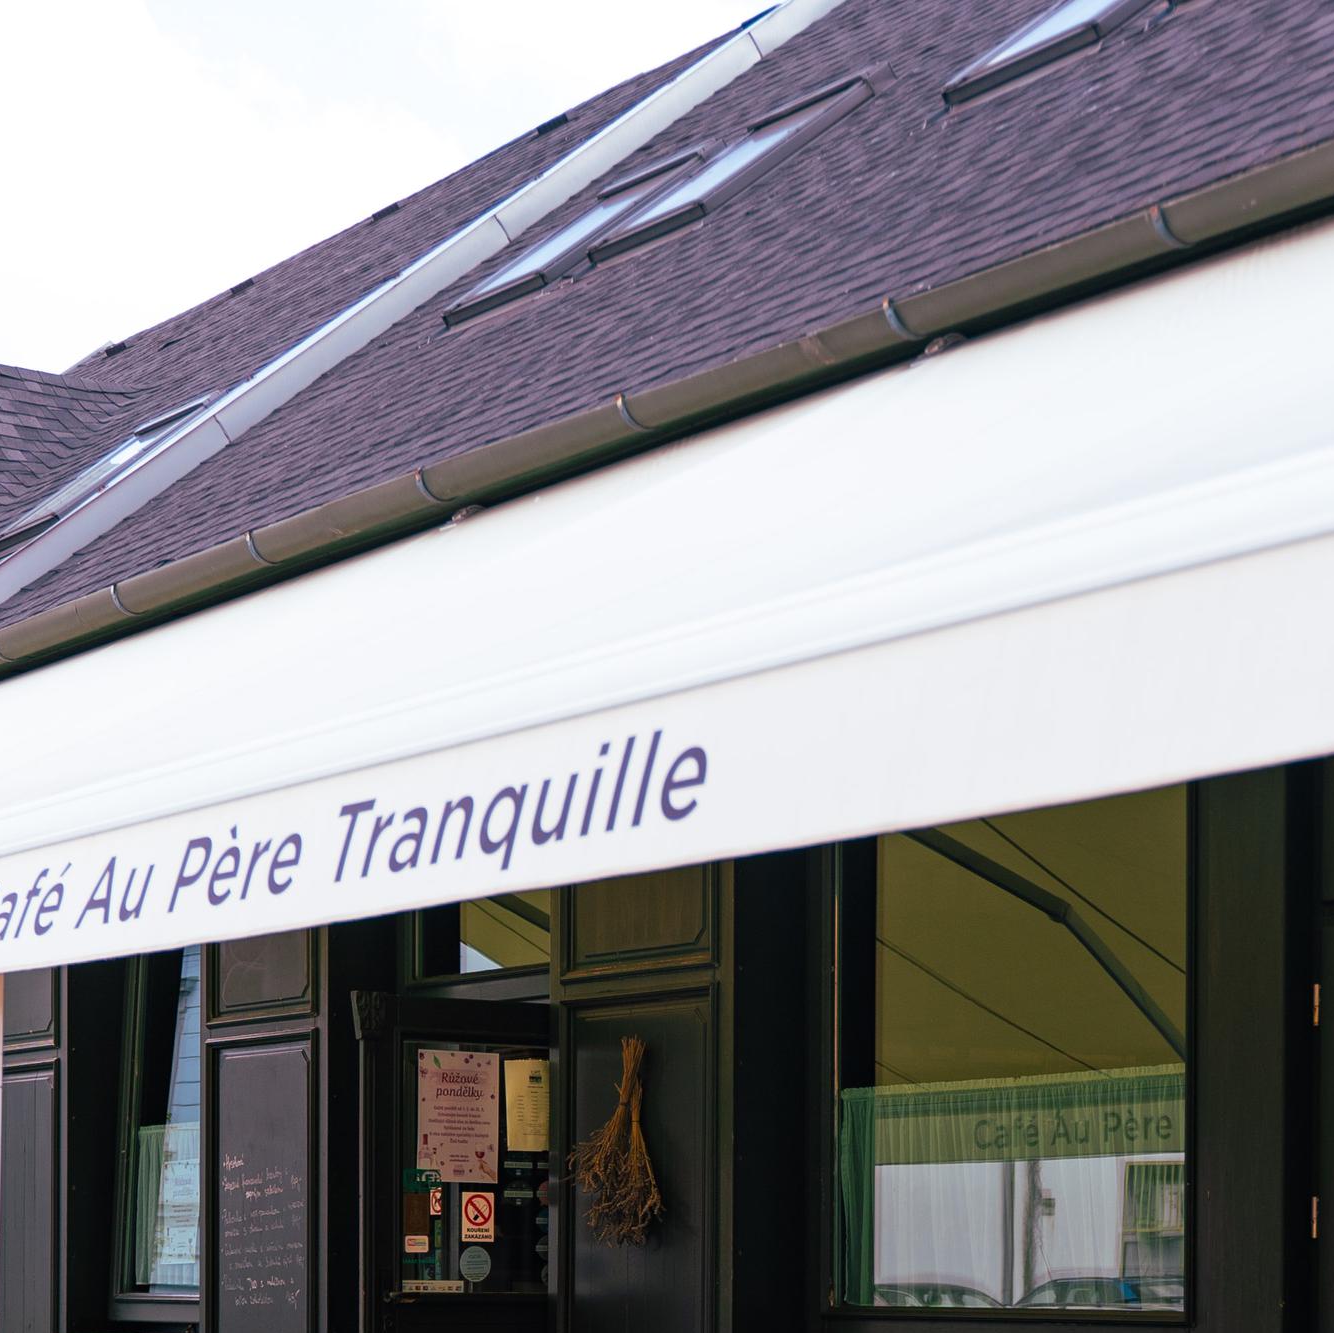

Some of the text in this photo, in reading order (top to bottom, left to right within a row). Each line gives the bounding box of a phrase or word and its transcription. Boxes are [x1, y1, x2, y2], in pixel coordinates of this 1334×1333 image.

[74, 856, 156, 931] Au
[167, 824, 303, 914] Père
[333, 728, 710, 884] Tranquille
